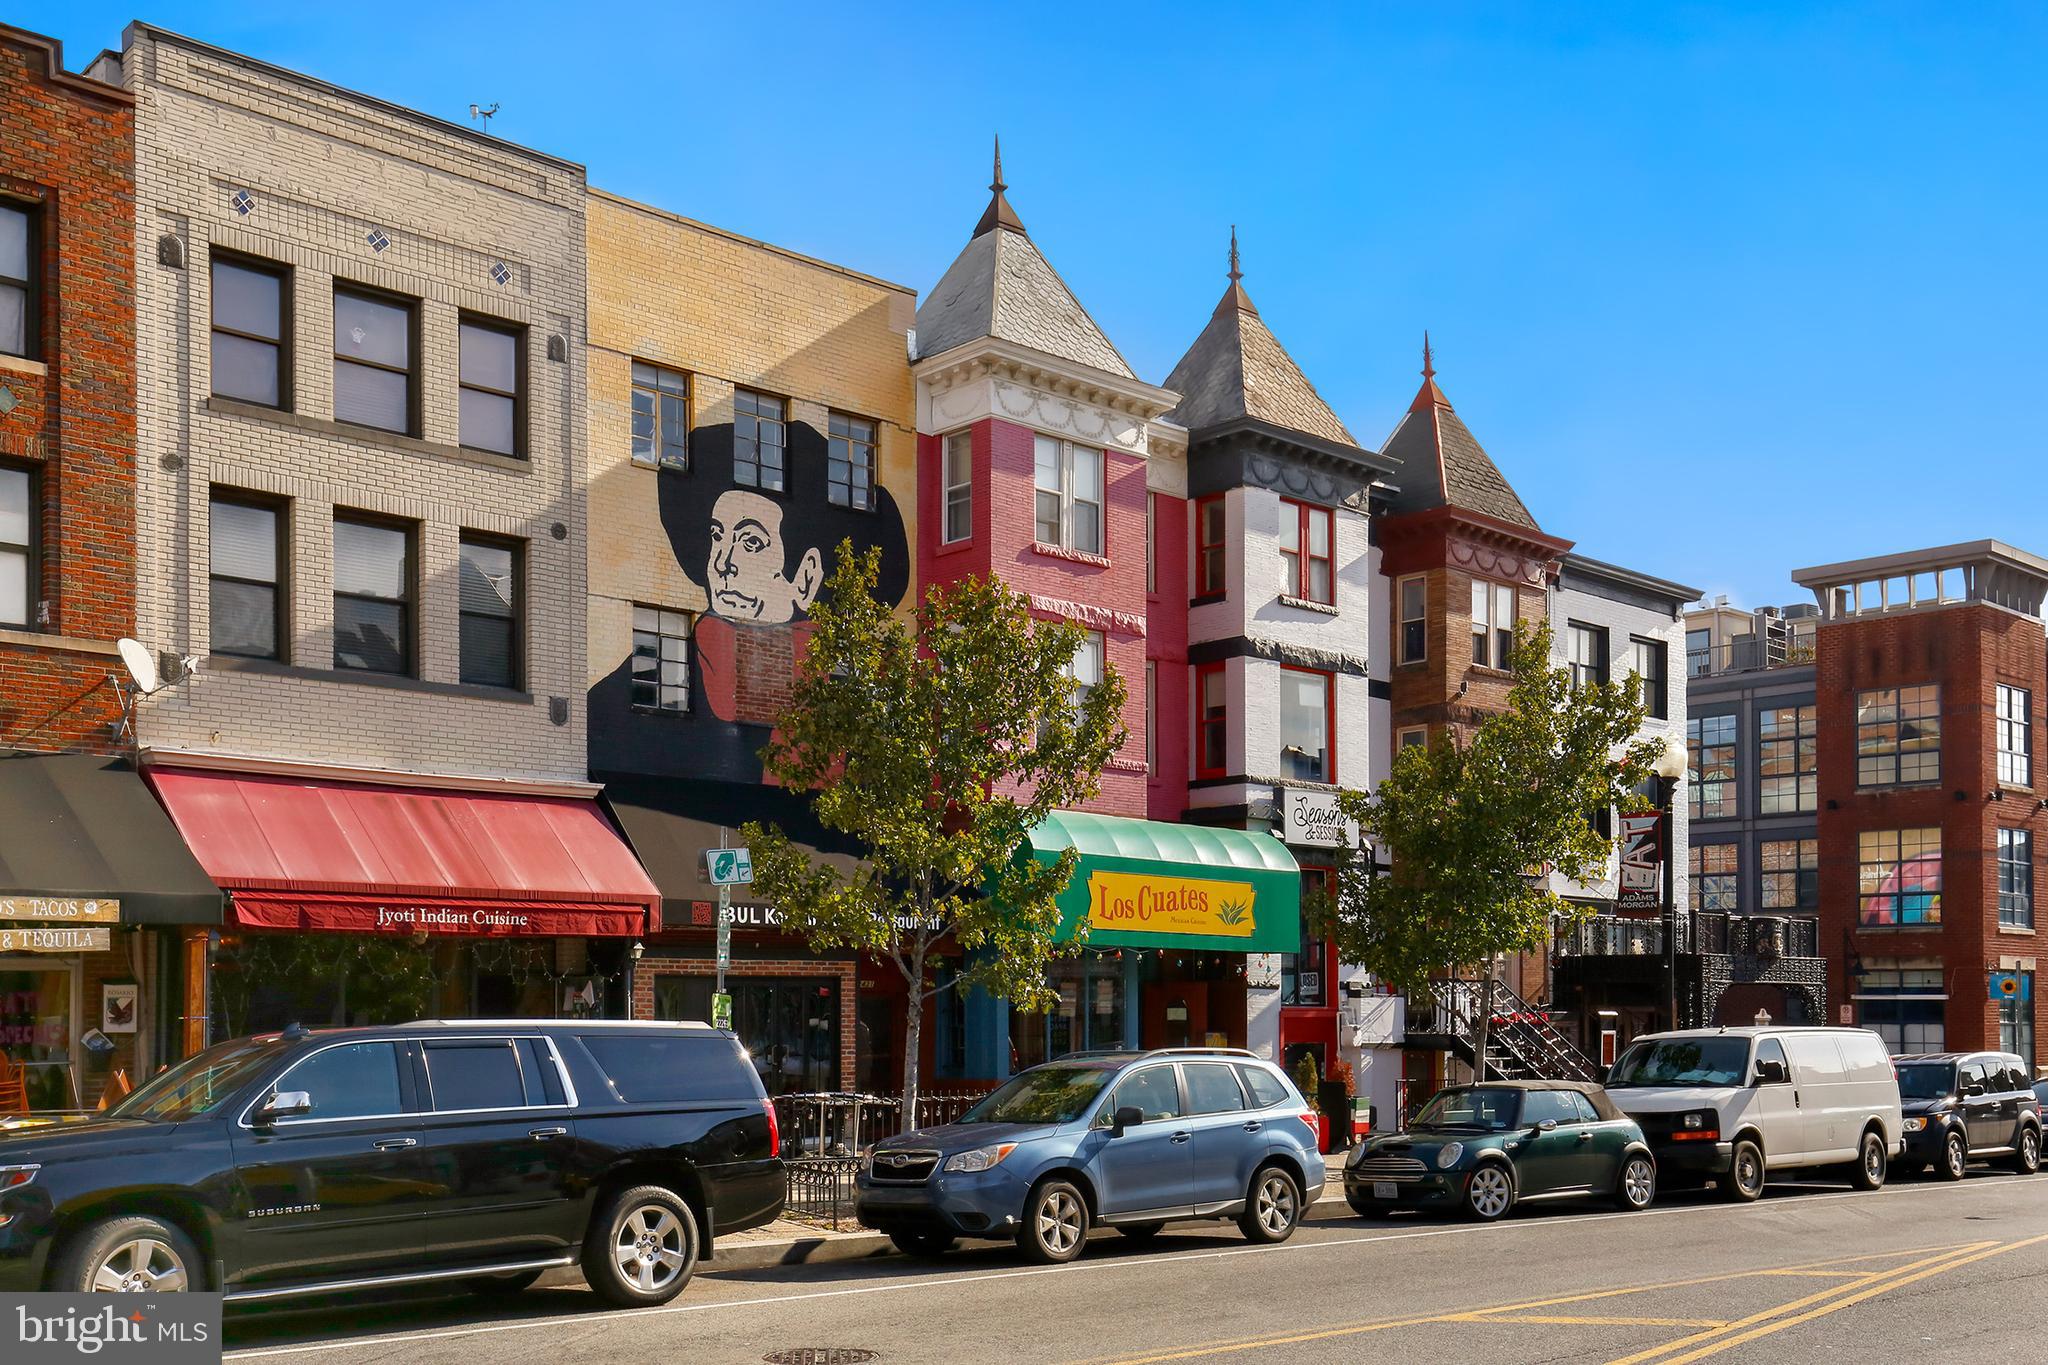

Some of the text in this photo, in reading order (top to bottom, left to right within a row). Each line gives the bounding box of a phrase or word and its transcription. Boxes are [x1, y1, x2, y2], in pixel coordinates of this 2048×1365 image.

[1099, 884, 1209, 921] Los Cuates
[1618, 901, 1658, 909] MORGAN
[1622, 894, 1655, 902] ADAMS
[29, 899, 78, 917] TACOS
[377, 907, 528, 926] Jyoti Indian Cuisine
[727, 906, 760, 925] BUL
[2, 931, 93, 949] & TEQUILA
[248, 1203, 321, 1218] SUBURBAN
